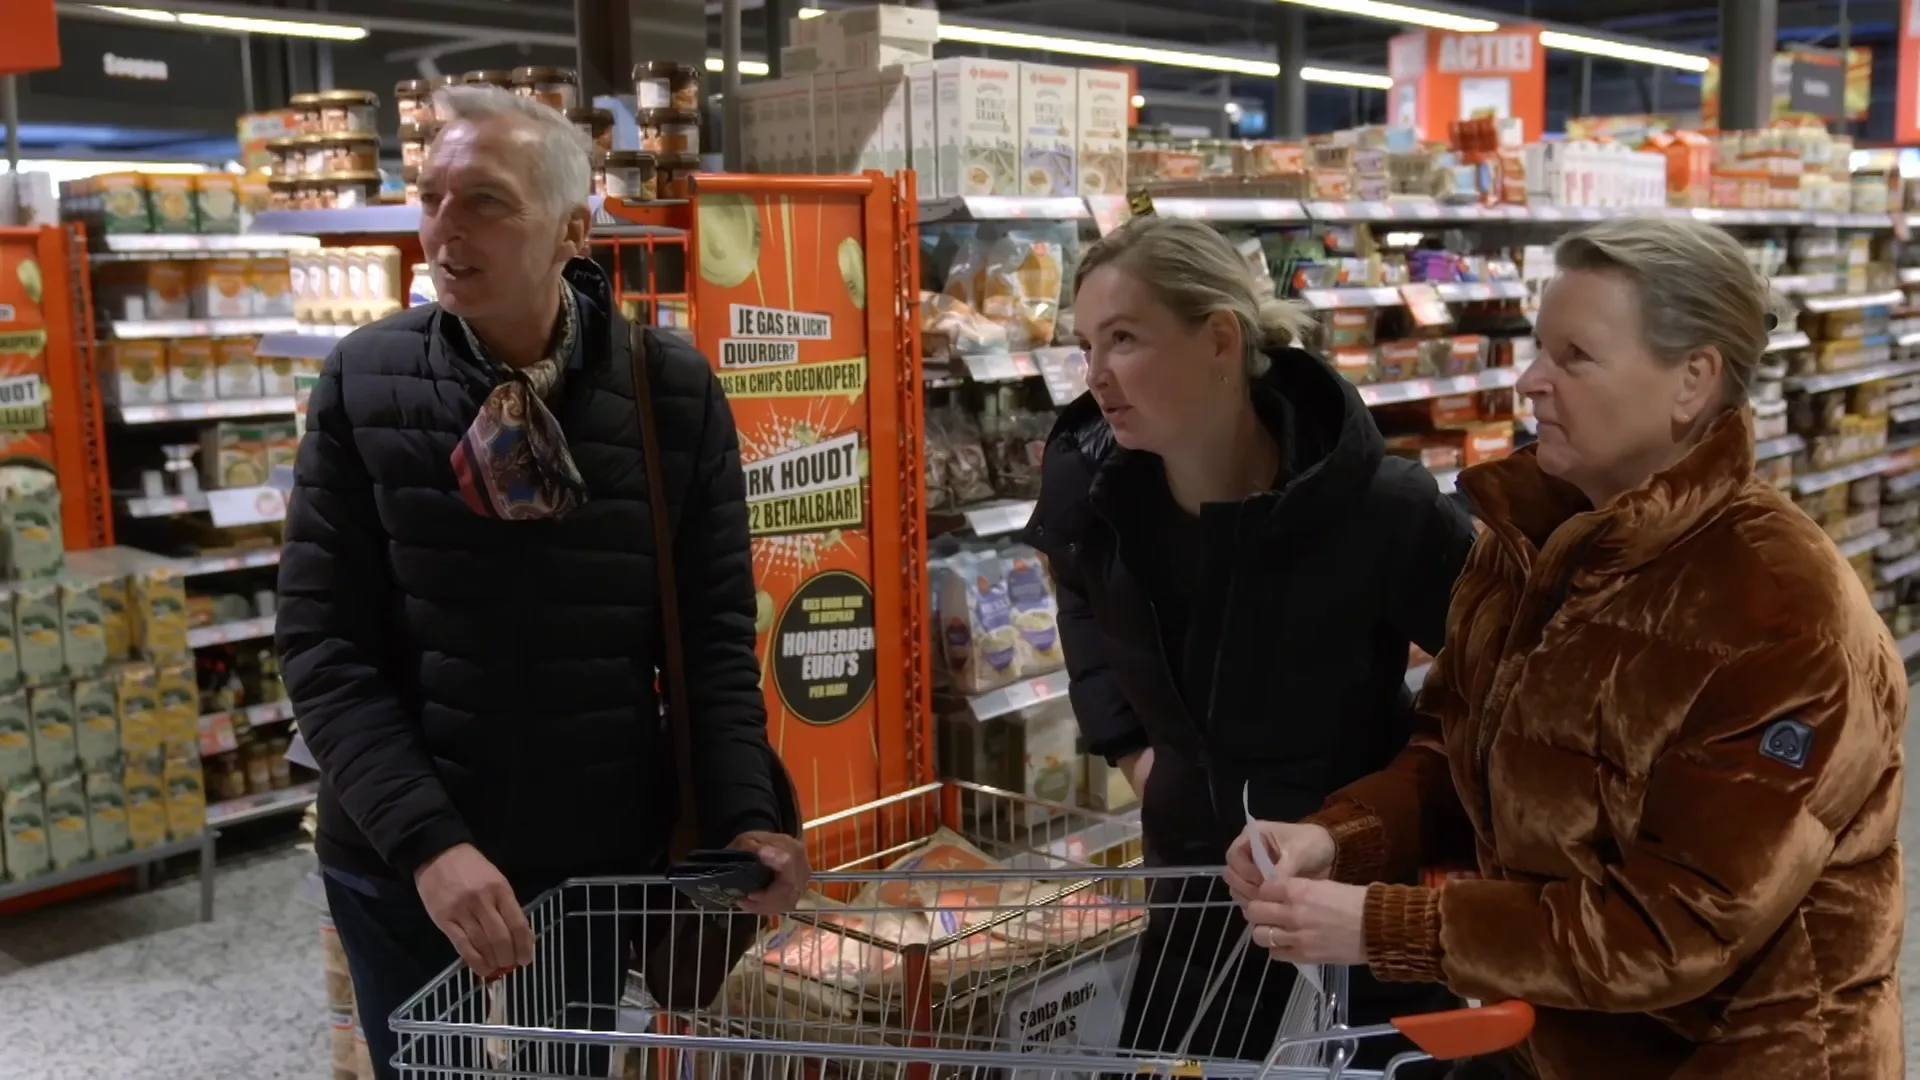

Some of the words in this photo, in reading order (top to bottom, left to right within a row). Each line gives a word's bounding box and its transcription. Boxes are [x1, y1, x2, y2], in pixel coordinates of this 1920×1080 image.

[738, 308, 754, 334] JE
[757, 311, 785, 336] GAS
[787, 316, 800, 335] EN
[802, 319, 828, 336] LICHT
[724, 343, 795, 364] DUURDER?
[735, 374, 747, 394] EN
[750, 371, 782, 393] CHIPS
[785, 363, 861, 391] GOEDKOPER!
[781, 443, 854, 490] HOUDT
[764, 488, 858, 528] BETAALBAAR!
[802, 652, 860, 680] EURO'S
[1020, 1000, 1059, 1031] Santa
